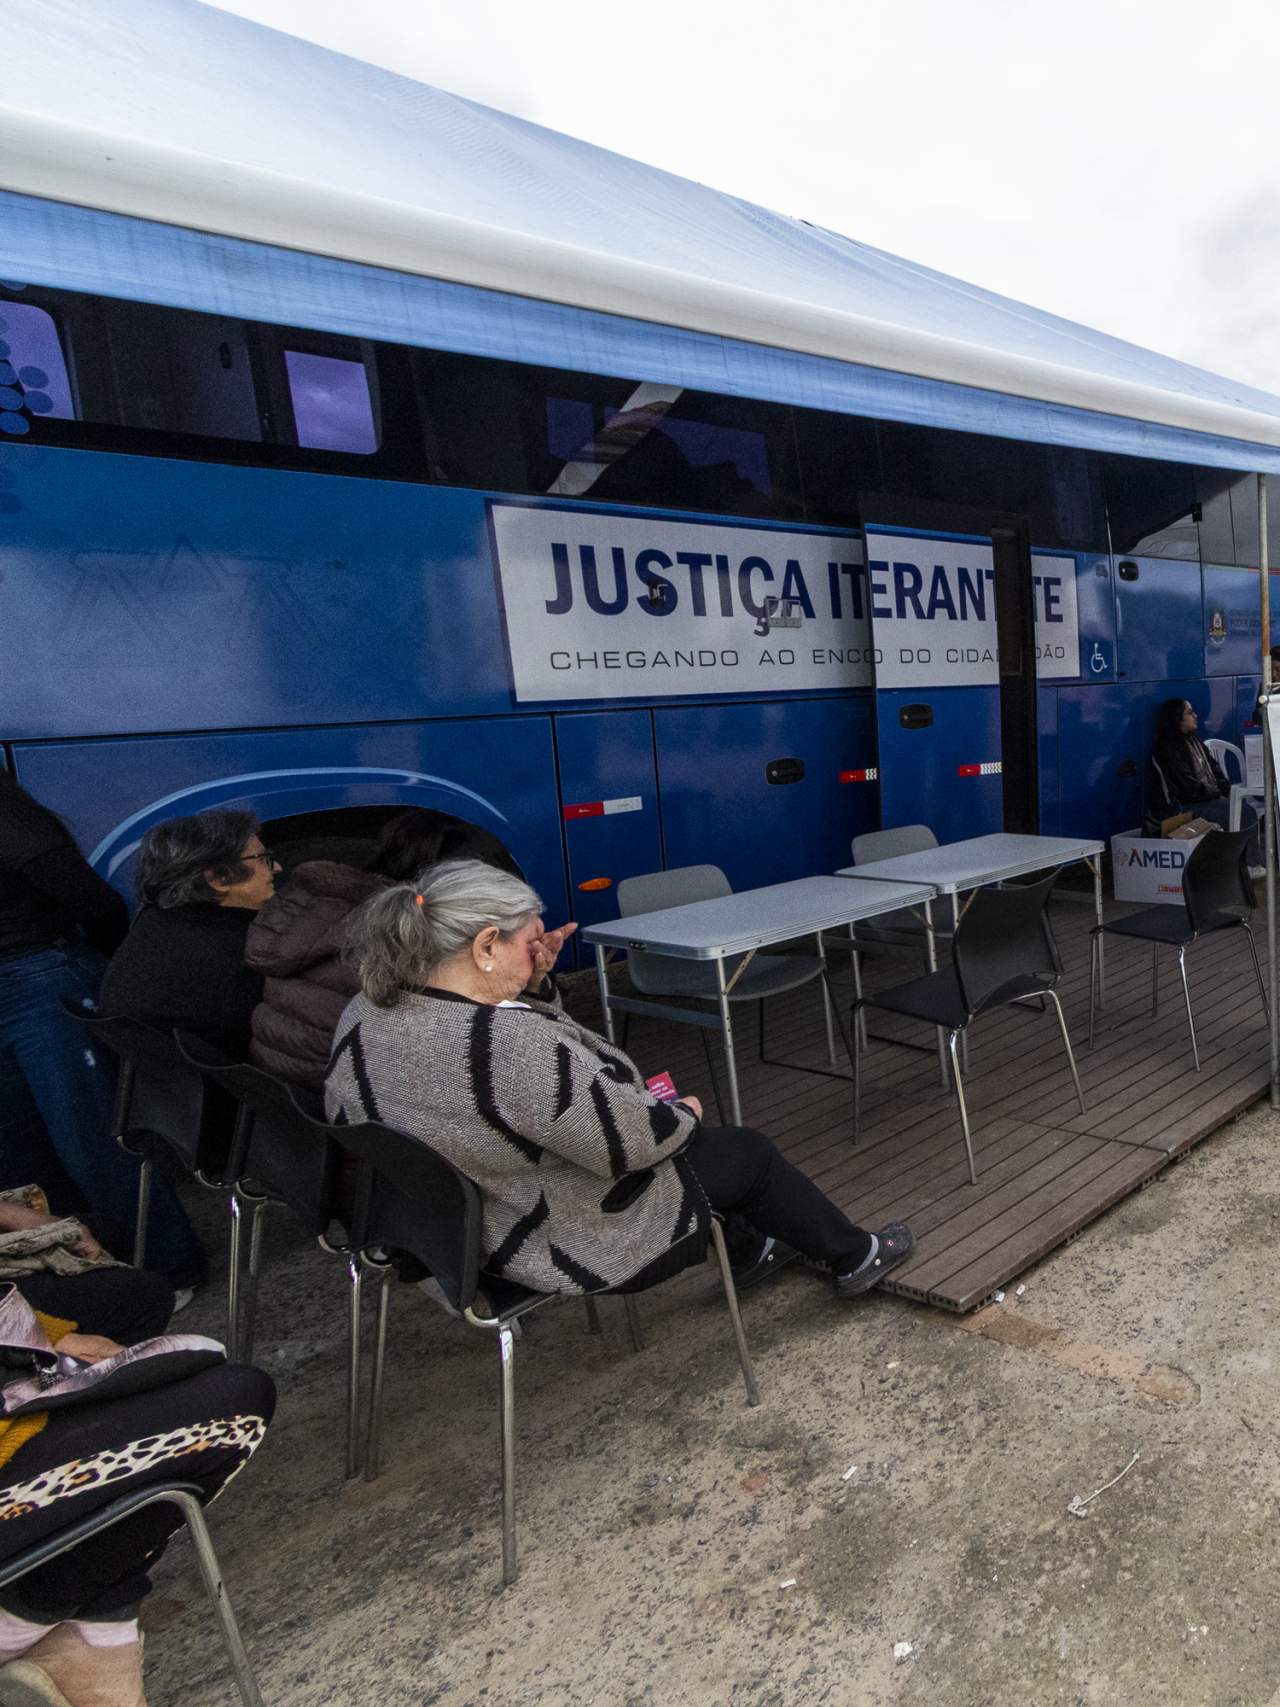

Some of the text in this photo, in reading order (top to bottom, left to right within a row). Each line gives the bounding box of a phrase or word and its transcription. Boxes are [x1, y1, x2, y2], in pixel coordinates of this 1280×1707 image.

[545, 543, 816, 637] JUSTIÇA
[550, 650, 739, 670] CHEGANDO
[758, 649, 795, 666] AO
[899, 648, 932, 665] DO
